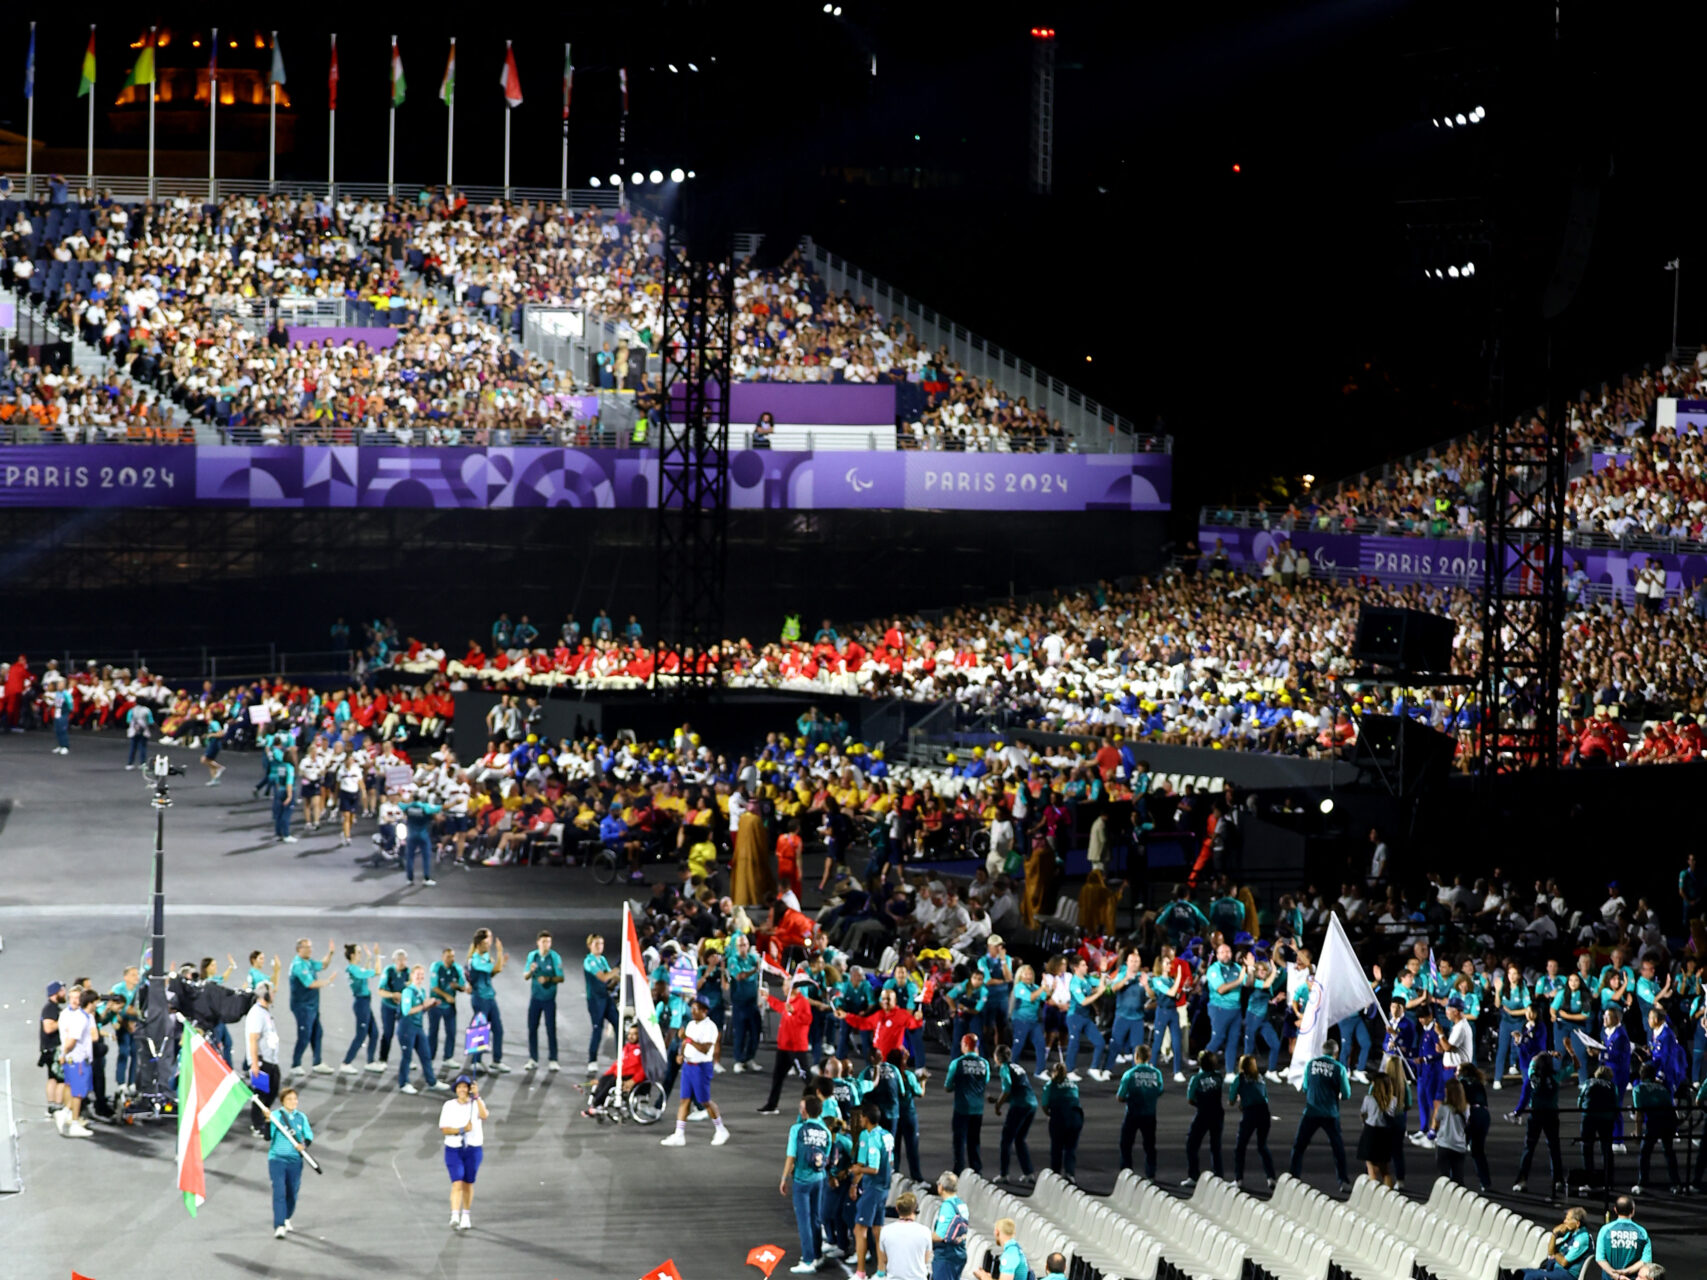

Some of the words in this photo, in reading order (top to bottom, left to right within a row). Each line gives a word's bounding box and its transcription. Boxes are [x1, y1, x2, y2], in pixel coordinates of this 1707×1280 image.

[6, 466, 89, 488] PARIS
[100, 467, 175, 488] 2024
[924, 472, 996, 492] PARIS
[1005, 473, 1068, 493] 2024
[1374, 552, 1432, 574] PARIS
[1610, 1230, 1638, 1240] PARIS
[1611, 1240, 1638, 1250] 2024
